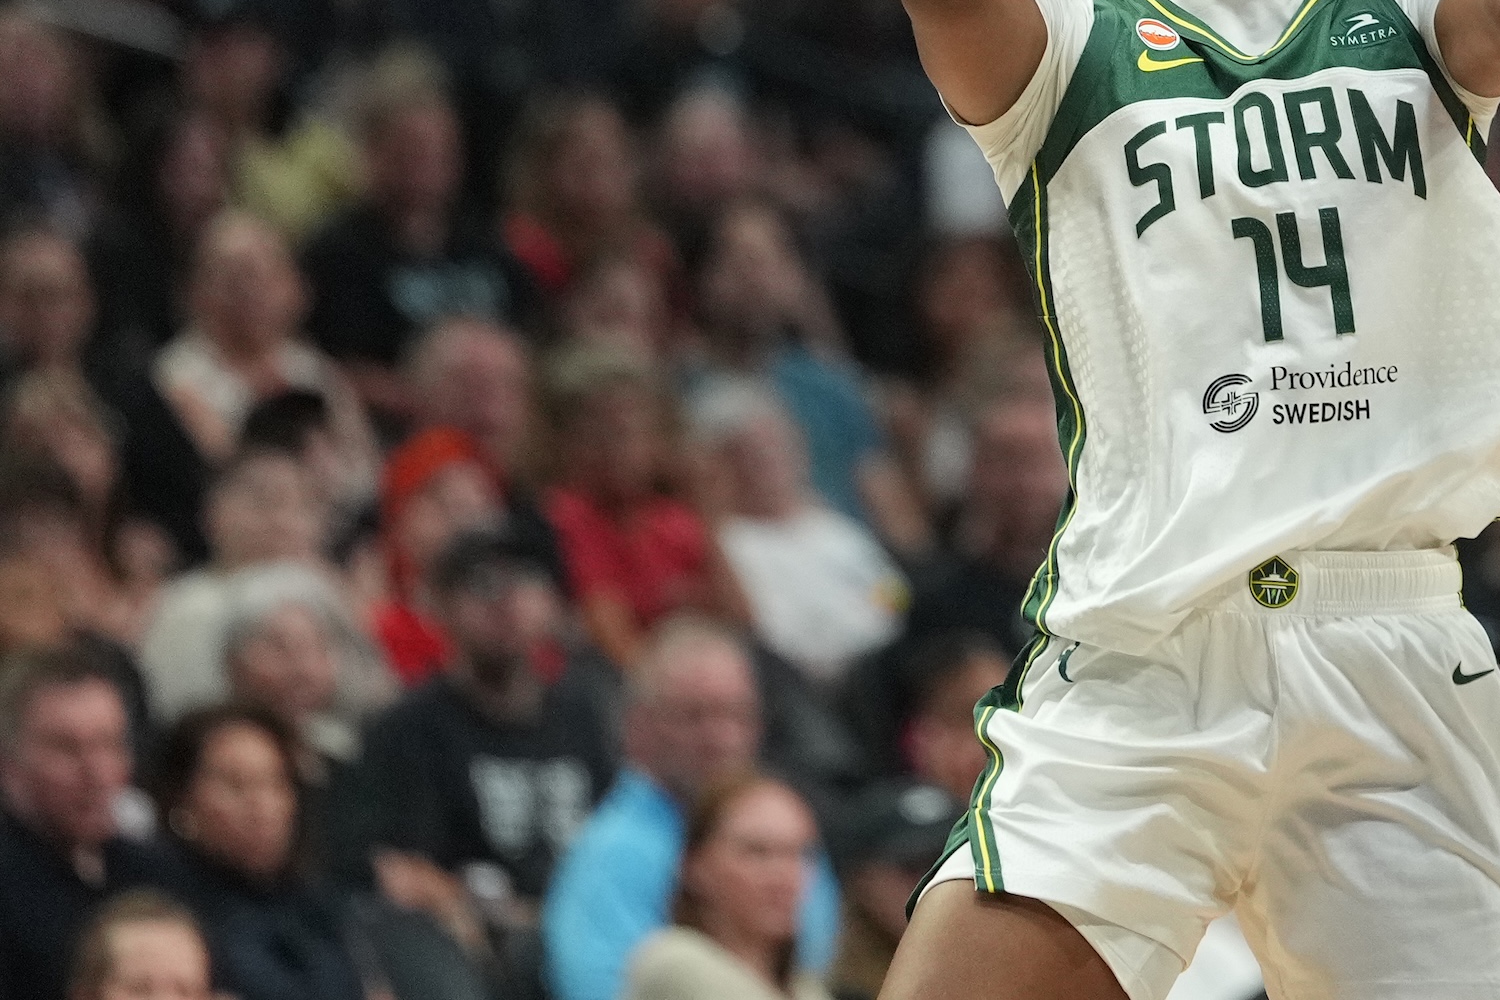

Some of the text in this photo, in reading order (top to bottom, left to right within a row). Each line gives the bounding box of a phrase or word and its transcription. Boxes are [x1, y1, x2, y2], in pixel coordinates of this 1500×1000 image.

[1330, 26, 1397, 47] SYMETRA
[1123, 86, 1427, 240] STORM
[1231, 206, 1356, 342] 14
[1270, 361, 1399, 391] Providence
[1272, 399, 1371, 425] SWEDISH
